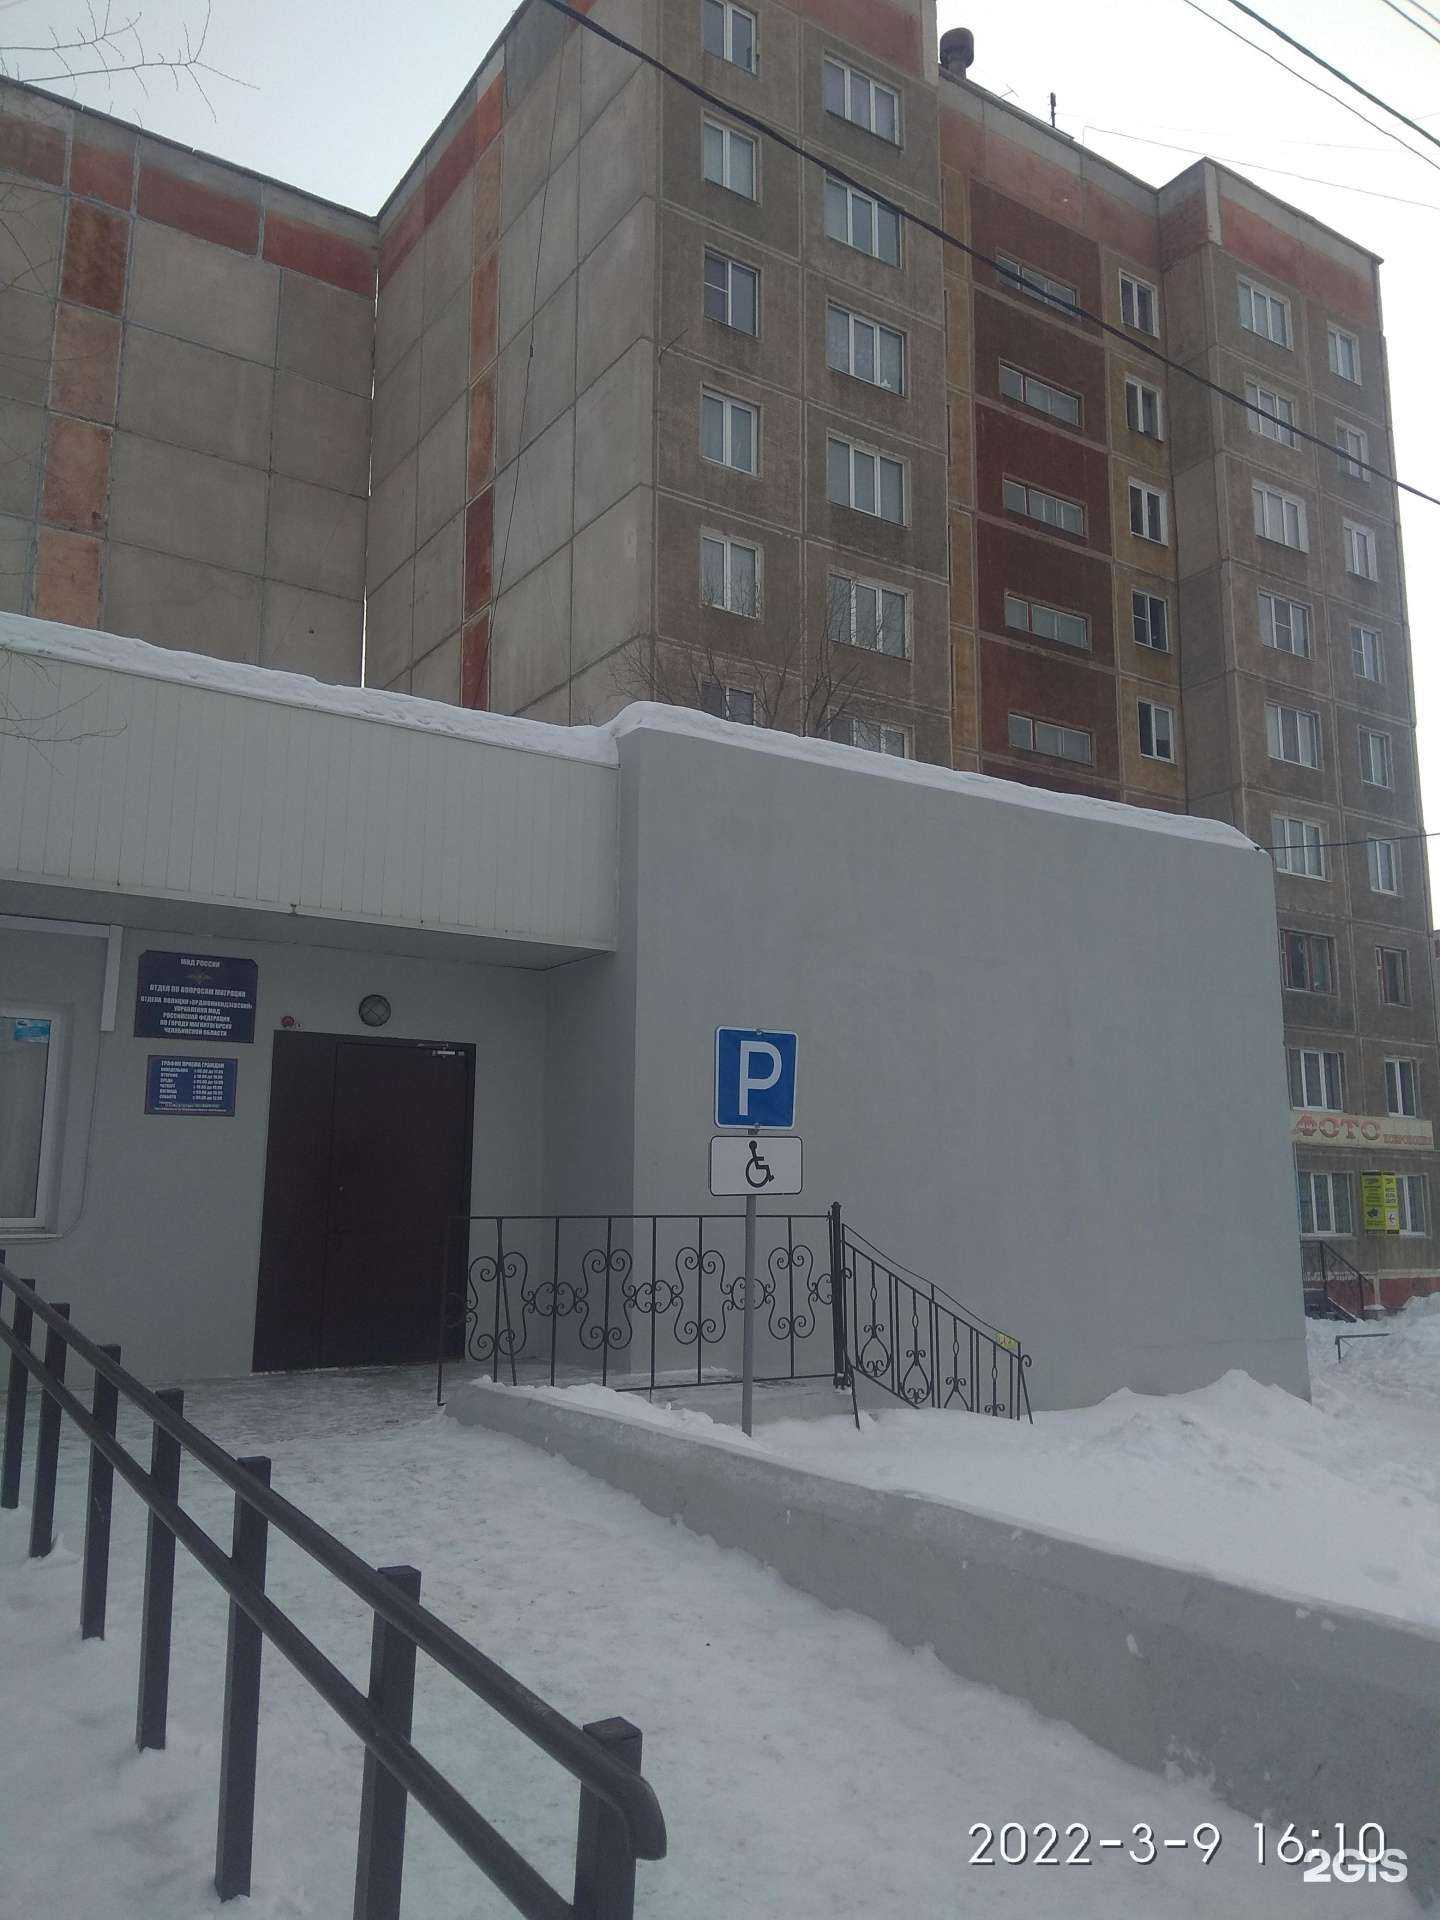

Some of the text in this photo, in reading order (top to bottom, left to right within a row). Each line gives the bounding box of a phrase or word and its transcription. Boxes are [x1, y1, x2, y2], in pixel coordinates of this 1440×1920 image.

[180, 958, 220, 968] МВД РОССИИ
[149, 984, 171, 992] ОТДЕЛ
[171, 985, 180, 993] ПО
[180, 986, 214, 995] ВОПРОСАМ
[738, 1040, 782, 1116] P
[1295, 1112, 1381, 1140] ФОТО
